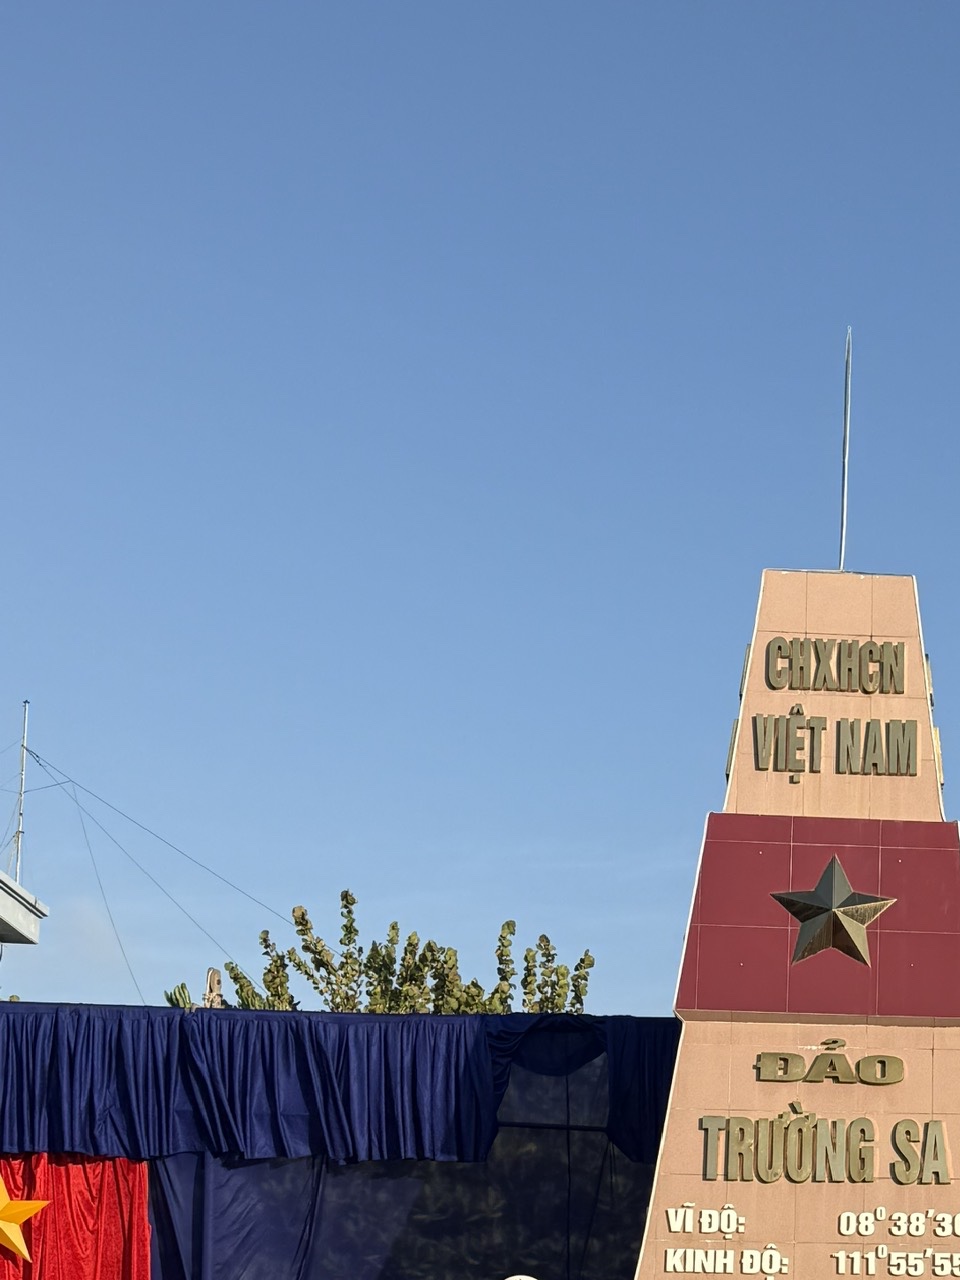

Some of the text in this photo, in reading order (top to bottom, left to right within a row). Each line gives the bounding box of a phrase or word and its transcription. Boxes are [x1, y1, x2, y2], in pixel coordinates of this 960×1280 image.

[766, 637, 905, 694] CHXHCN
[752, 704, 918, 784] VIỆT NAM
[752, 1038, 904, 1084] ĐẢO
[699, 1101, 951, 1185] TRƯỜNG SA
[666, 1202, 695, 1233] VĨ
[698, 1203, 746, 1240] ĐỘ:
[664, 1248, 734, 1274] KINH
